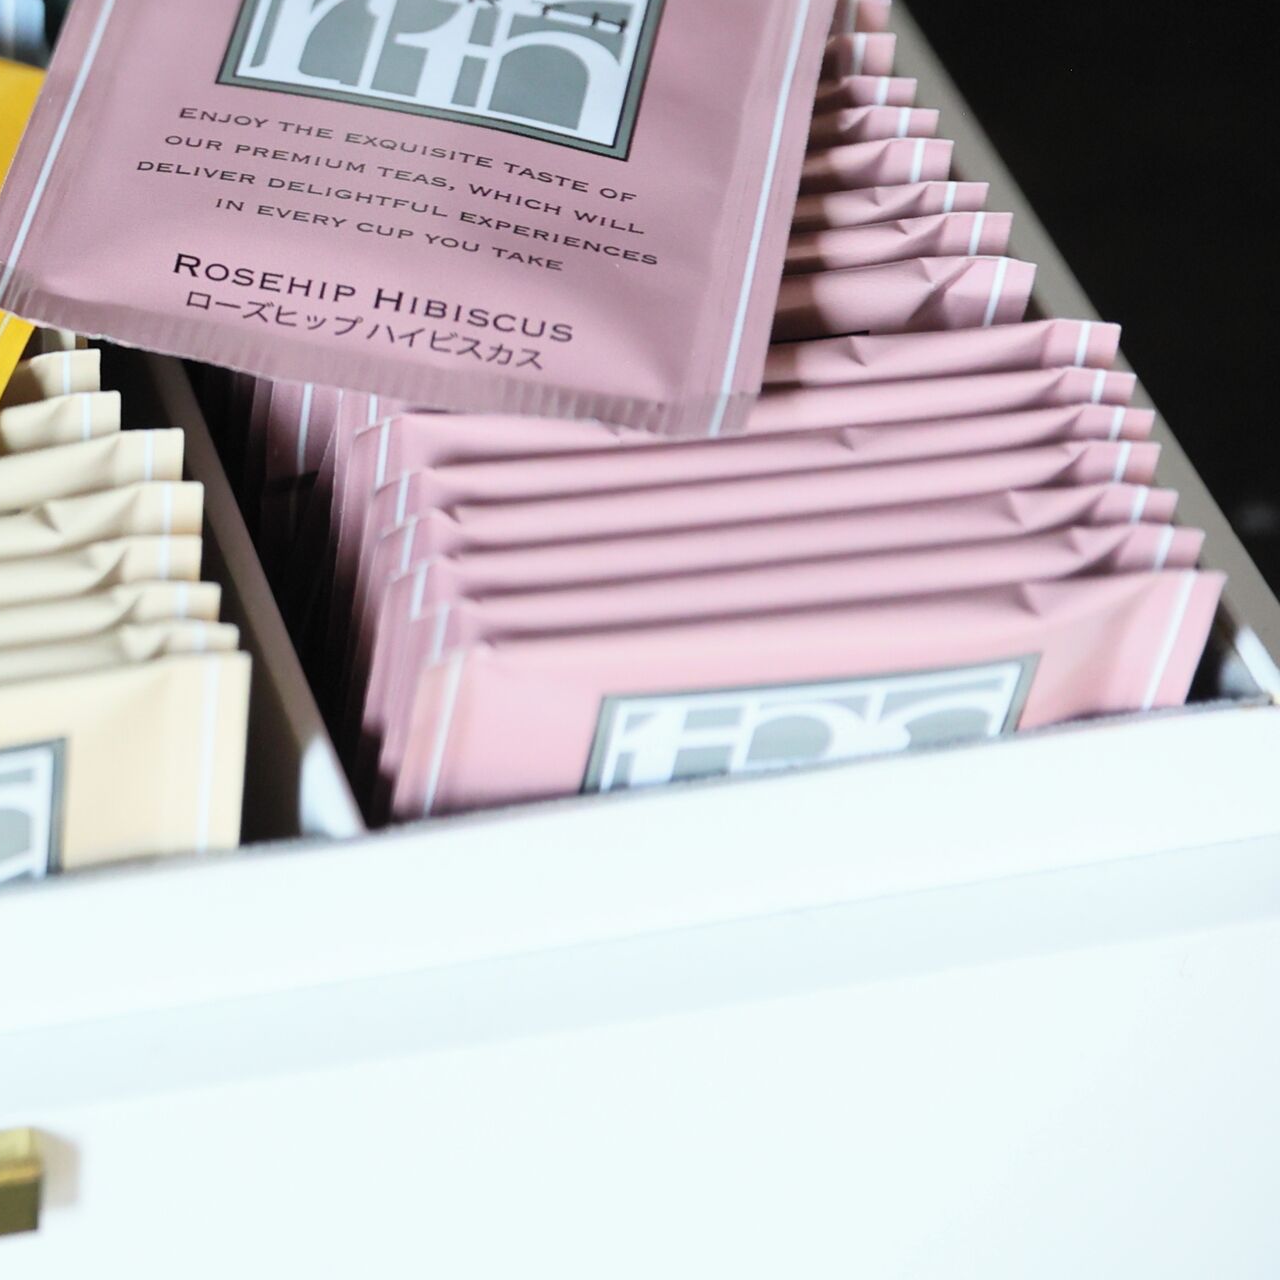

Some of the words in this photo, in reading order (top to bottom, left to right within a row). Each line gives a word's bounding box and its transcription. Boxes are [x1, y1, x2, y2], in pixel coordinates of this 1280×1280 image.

[165, 135, 224, 151] OUR
[235, 144, 366, 173] PREMIUM
[377, 167, 456, 192] TEAS,
[468, 184, 563, 217] WHICH
[573, 209, 645, 235] WILL
[179, 107, 270, 128] ENJOY
[278, 121, 334, 139] THE
[345, 132, 494, 169] EXQUISITE
[503, 162, 589, 193] TASTE
[599, 187, 638, 204] OF
[137, 161, 257, 185] DELIVER
[267, 177, 448, 218] DELIGHTFUL
[459, 212, 658, 265] EXPERIENCES
[215, 198, 246, 211] IN
[257, 204, 347, 228] EVERY
[356, 221, 415, 239] CUP
[424, 233, 481, 253] YOU
[492, 247, 564, 271] TAKE
[172, 253, 357, 303] ROSEHIP
[374, 289, 574, 343] HIBISCUS
[186, 290, 544, 370] ローズヒップハイビスカス
